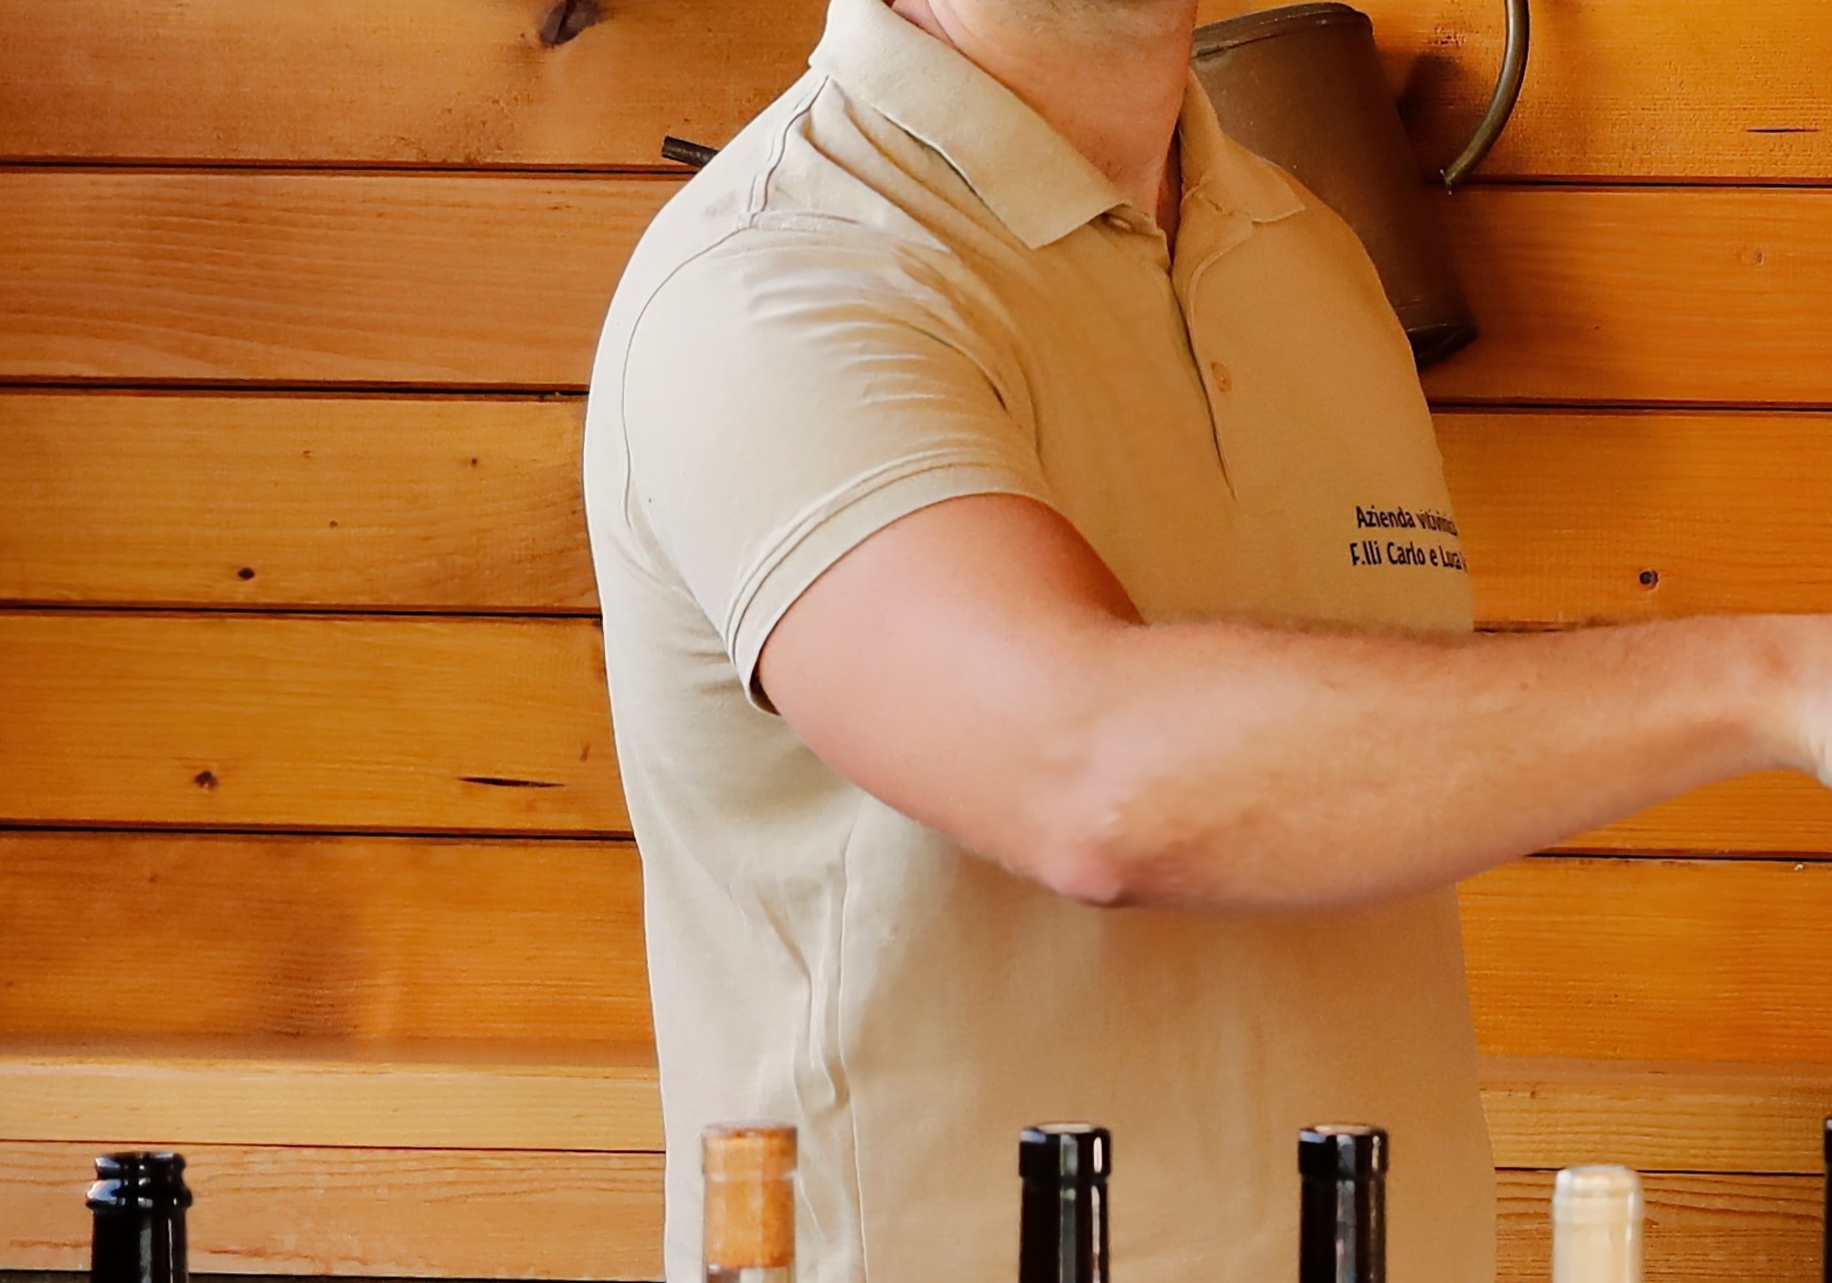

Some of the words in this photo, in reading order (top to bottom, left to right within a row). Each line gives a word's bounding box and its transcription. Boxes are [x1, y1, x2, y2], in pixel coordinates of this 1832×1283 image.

[1355, 505, 1416, 529] Azienda
[1350, 540, 1382, 566] F.lli
[1386, 541, 1426, 566] Carlo
[1429, 548, 1439, 567] e
